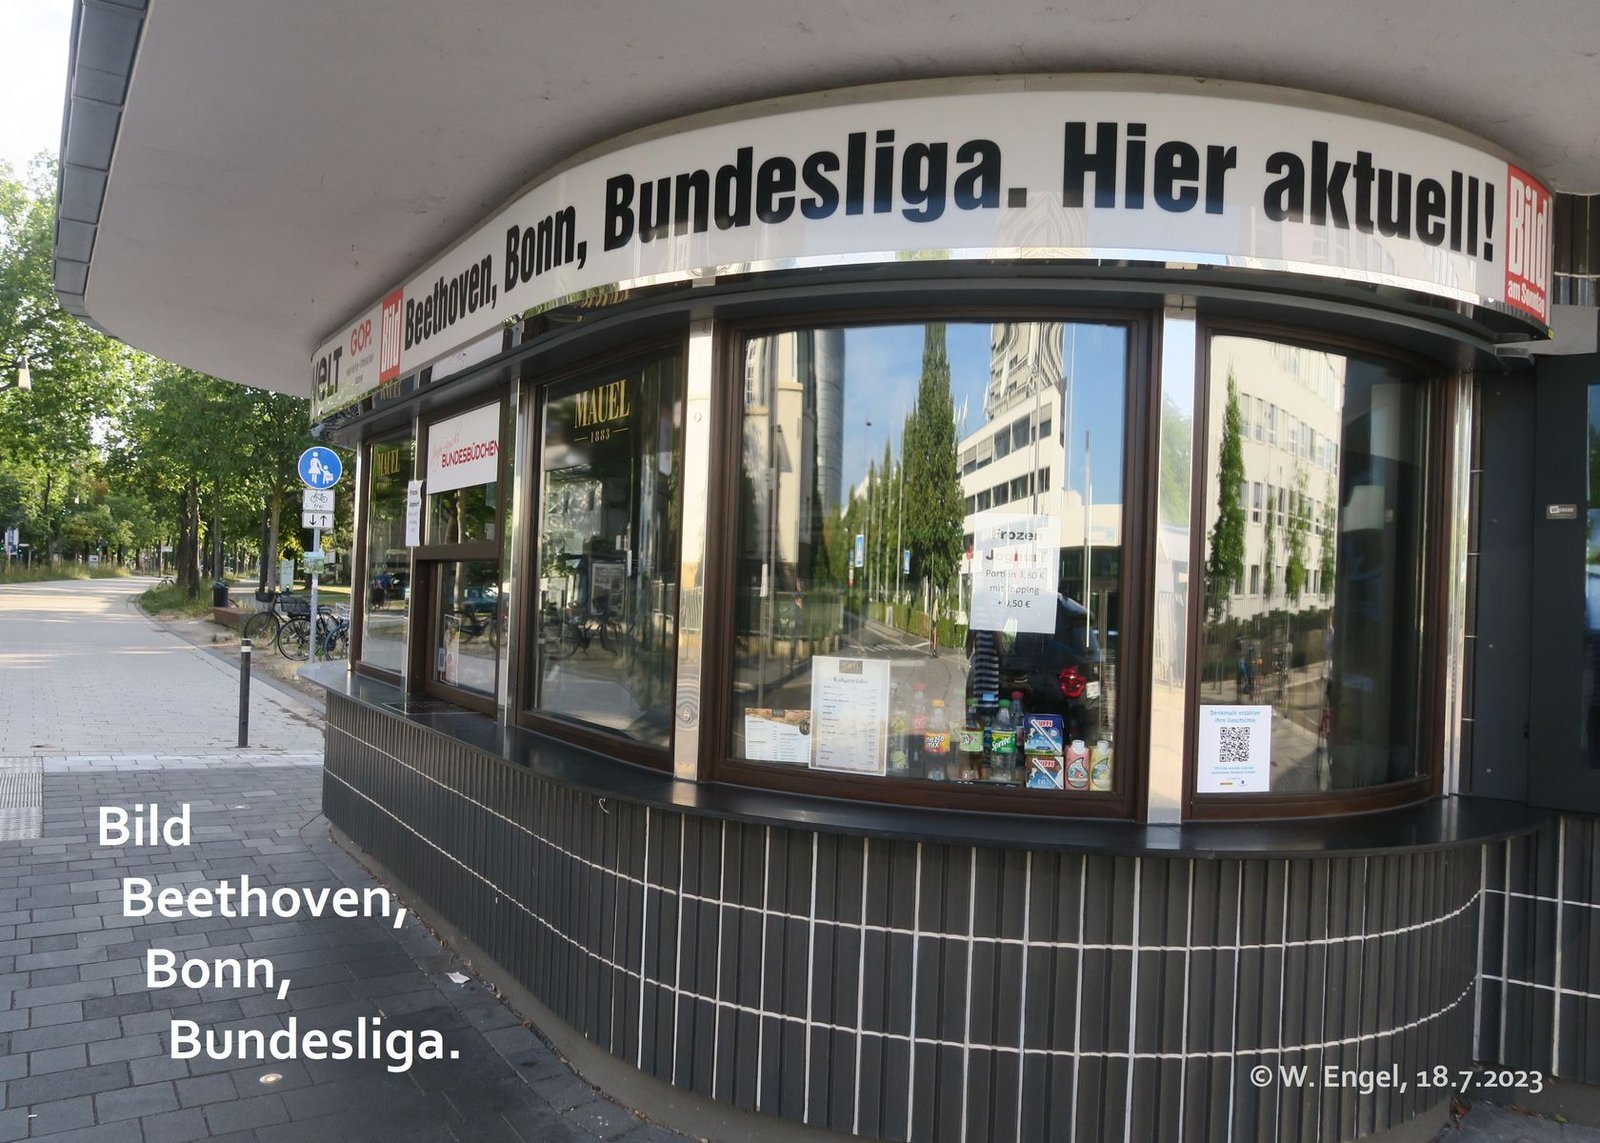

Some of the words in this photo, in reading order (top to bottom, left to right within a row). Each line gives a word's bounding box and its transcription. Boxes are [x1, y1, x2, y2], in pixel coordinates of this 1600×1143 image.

[404, 254, 498, 351] Beethoven,
[504, 205, 587, 294] Bonn,
[603, 129, 1028, 252] Bundesliga.
[1062, 121, 1237, 215] Hier
[1263, 139, 1495, 263] aktuell!
[1507, 175, 1548, 292] Bild
[1507, 279, 1521, 302] am
[381, 298, 401, 374] Bild
[574, 379, 631, 429] MAUEL
[590, 428, 611, 444] 1883
[441, 439, 499, 469] BUNDESBÜDCHEN
[1025, 599, 1032, 608] €
[991, 736, 1011, 752] Sprite
